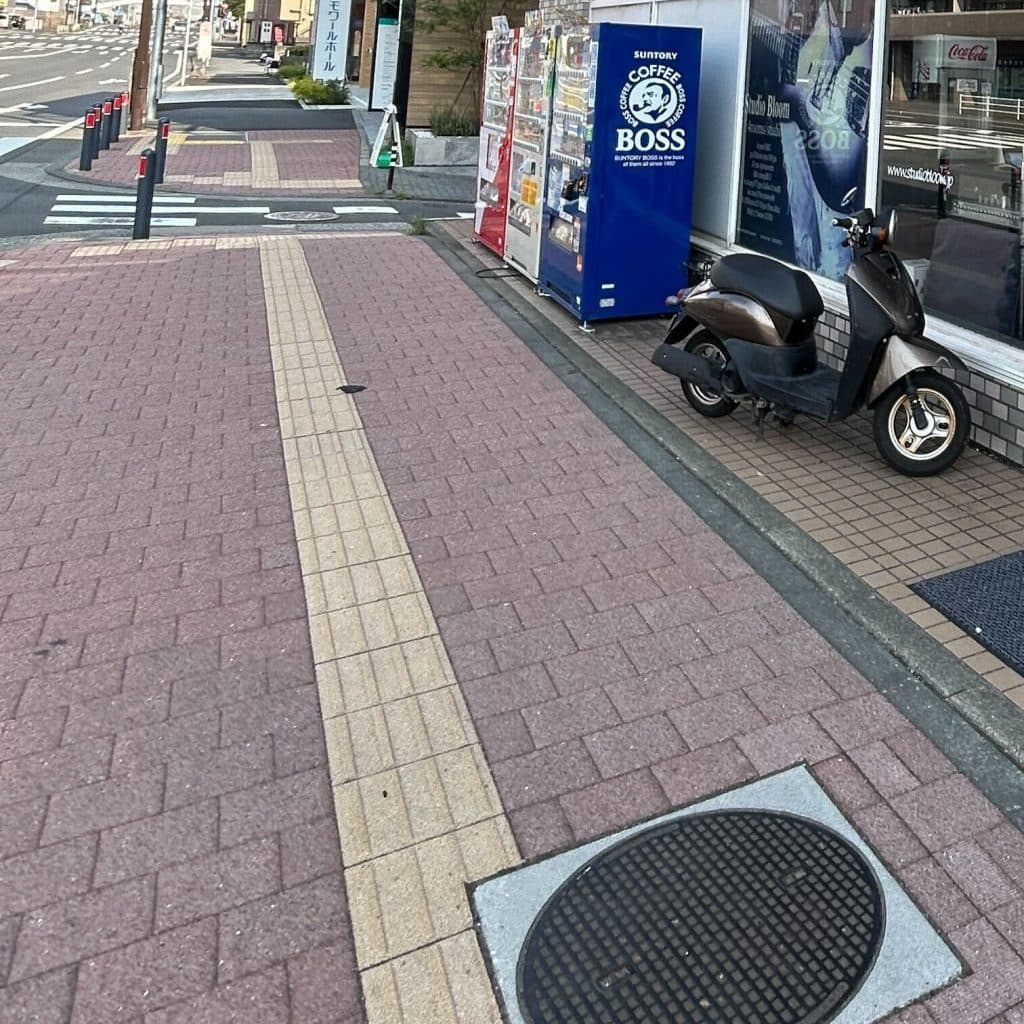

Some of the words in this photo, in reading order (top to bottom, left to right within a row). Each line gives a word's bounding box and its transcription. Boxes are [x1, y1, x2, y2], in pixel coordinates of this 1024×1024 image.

[633, 50, 678, 60] SUNTORY
[949, 43, 990, 61] Coca-Cola
[628, 64, 682, 84] COFFEE
[767, 94, 791, 120] Bloom
[615, 128, 686, 152] BOSS
